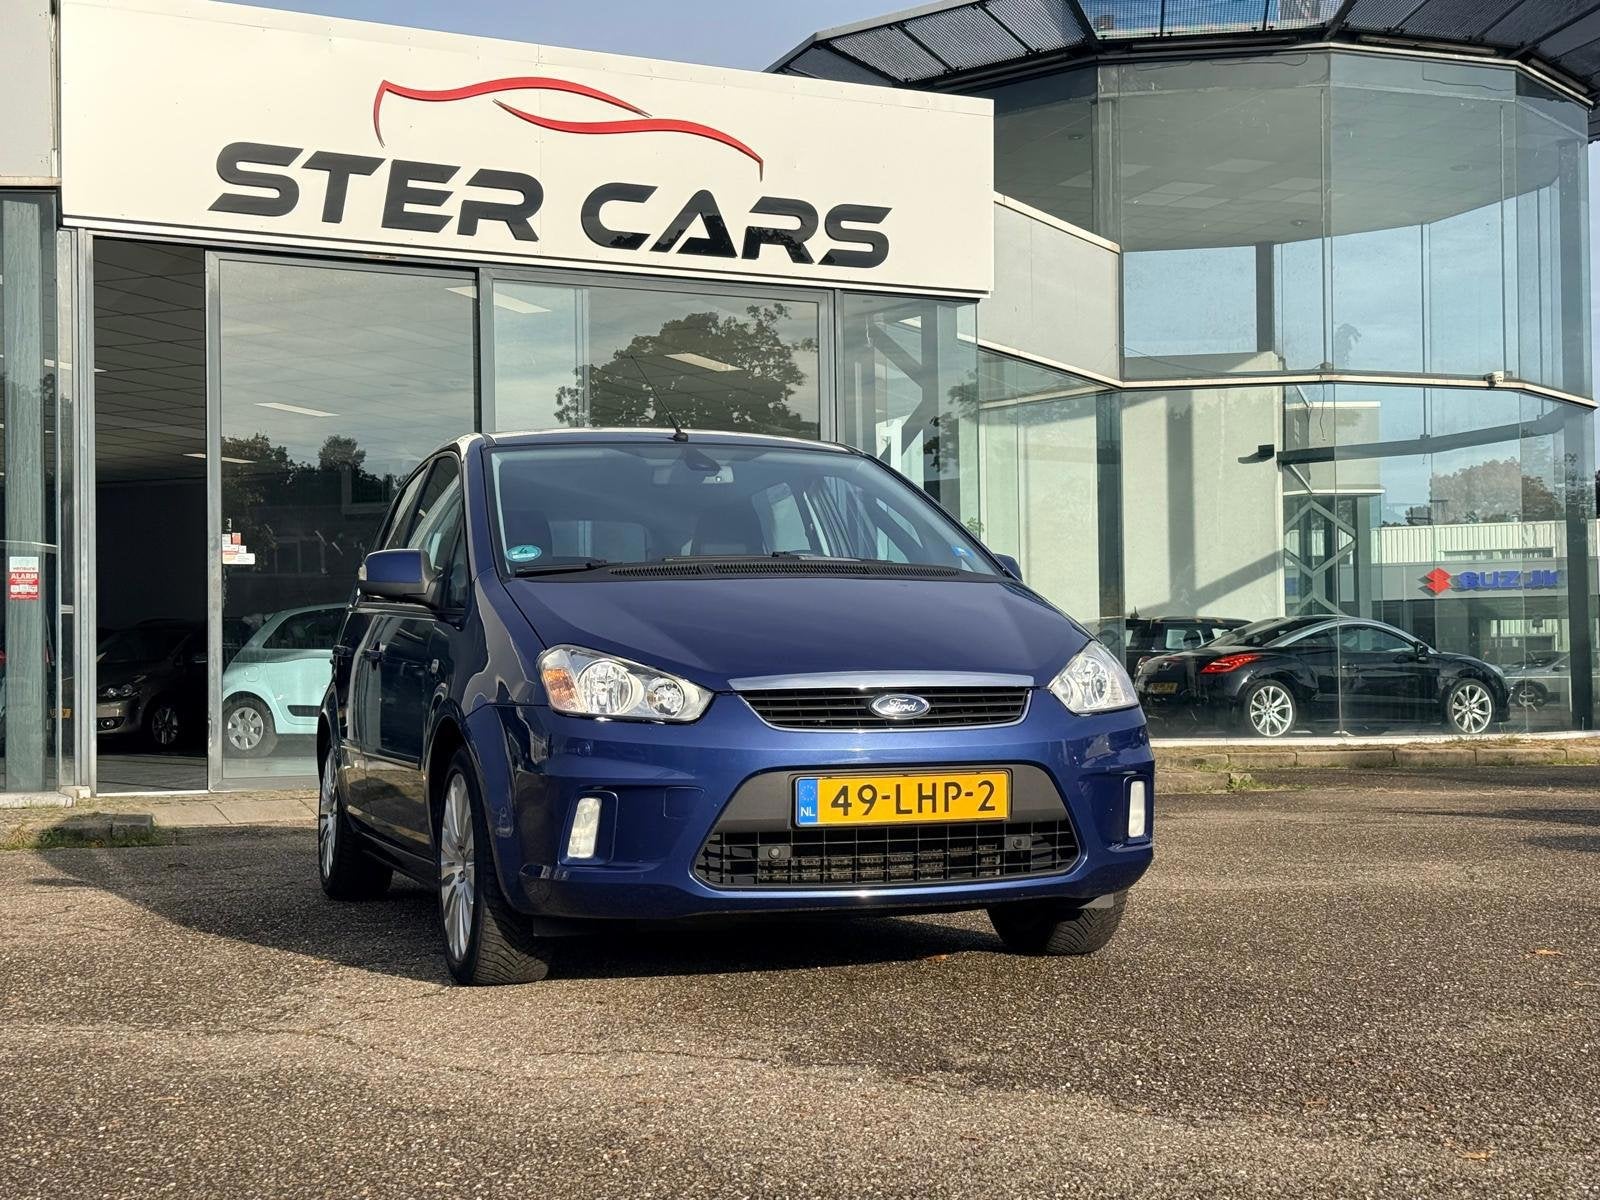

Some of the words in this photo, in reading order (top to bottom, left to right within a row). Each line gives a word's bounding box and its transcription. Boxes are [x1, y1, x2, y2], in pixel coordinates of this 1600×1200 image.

[207, 142, 543, 241] STER
[580, 182, 892, 268] CARS
[886, 698, 917, 712] Ford
[800, 806, 816, 817] NL
[830, 780, 996, 816] 49-LHP-2
